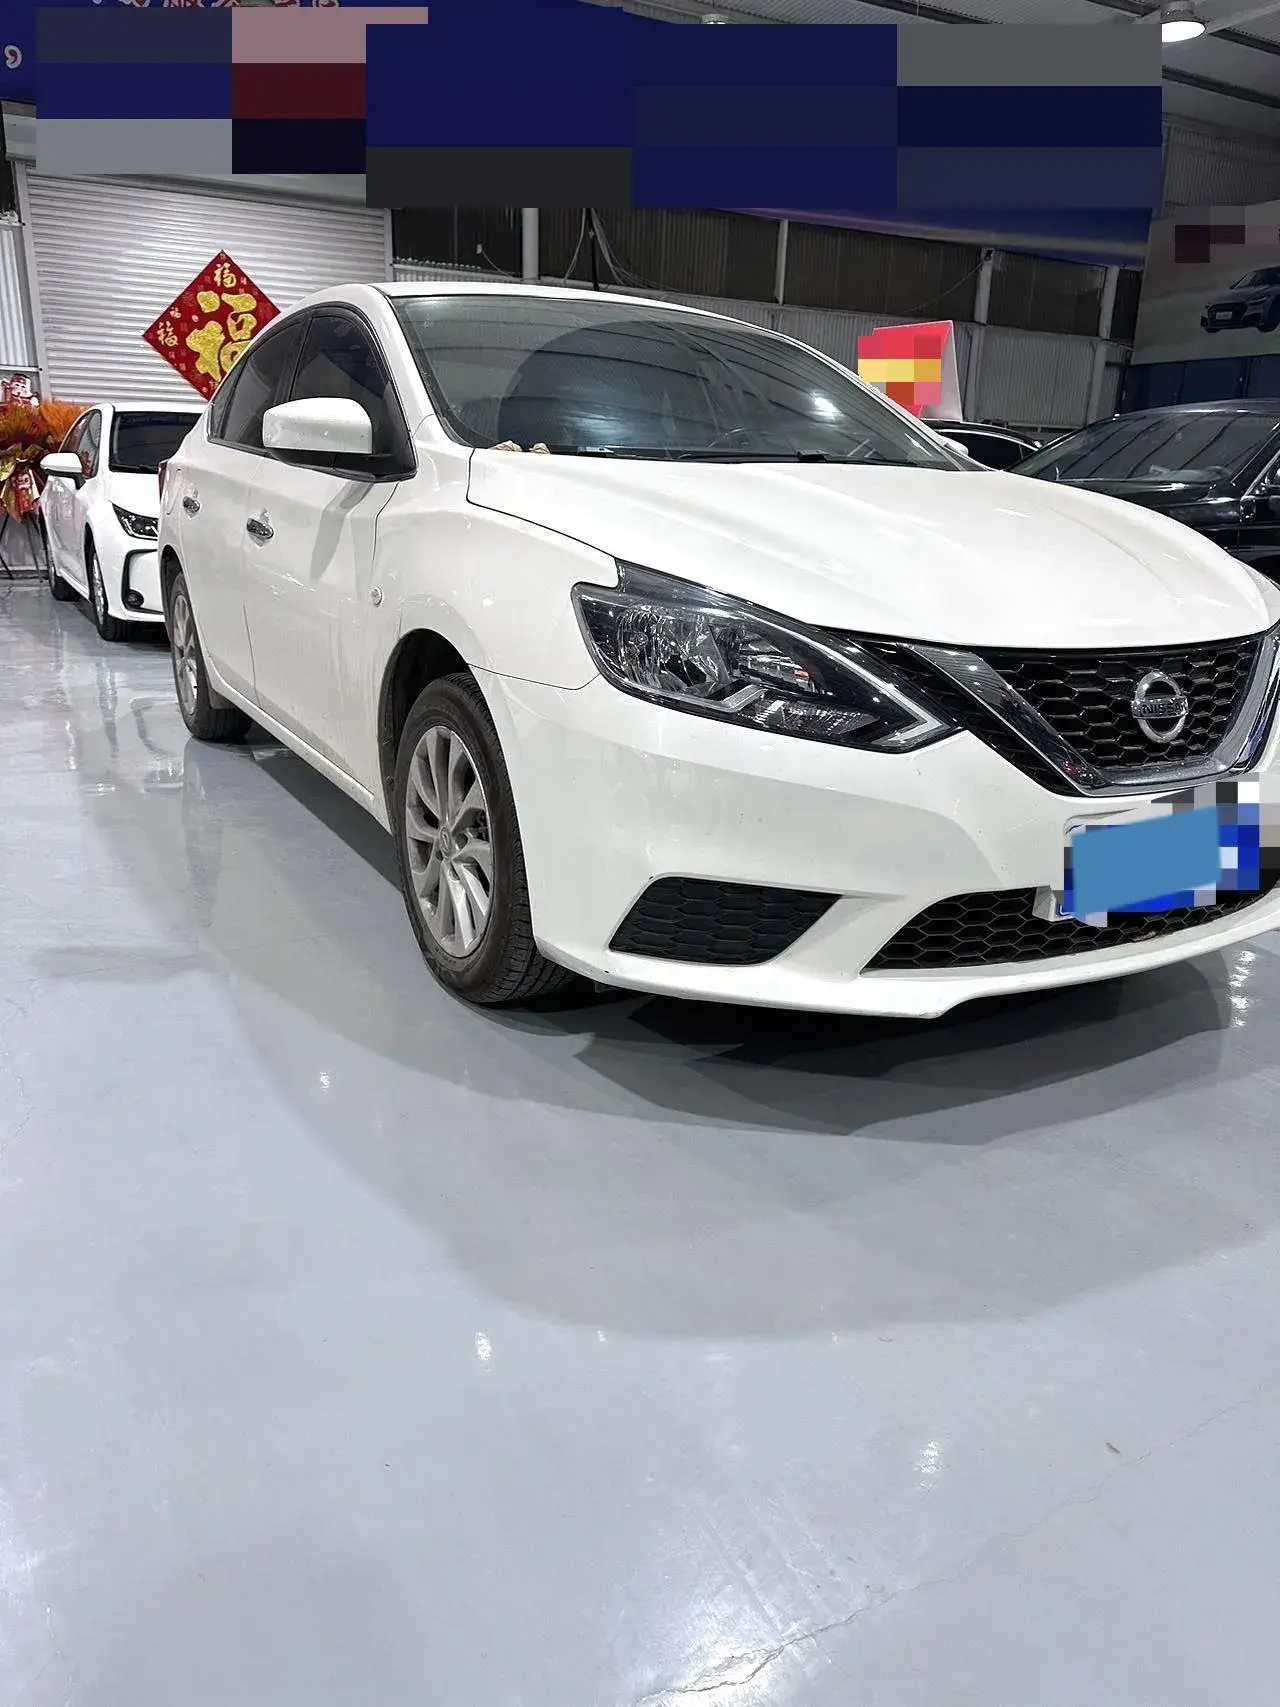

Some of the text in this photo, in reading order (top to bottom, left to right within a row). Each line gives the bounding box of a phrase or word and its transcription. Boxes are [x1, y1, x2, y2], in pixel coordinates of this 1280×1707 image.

[214, 262, 237, 288] 福
[156, 320, 179, 347] 福
[185, 290, 258, 383] 福
